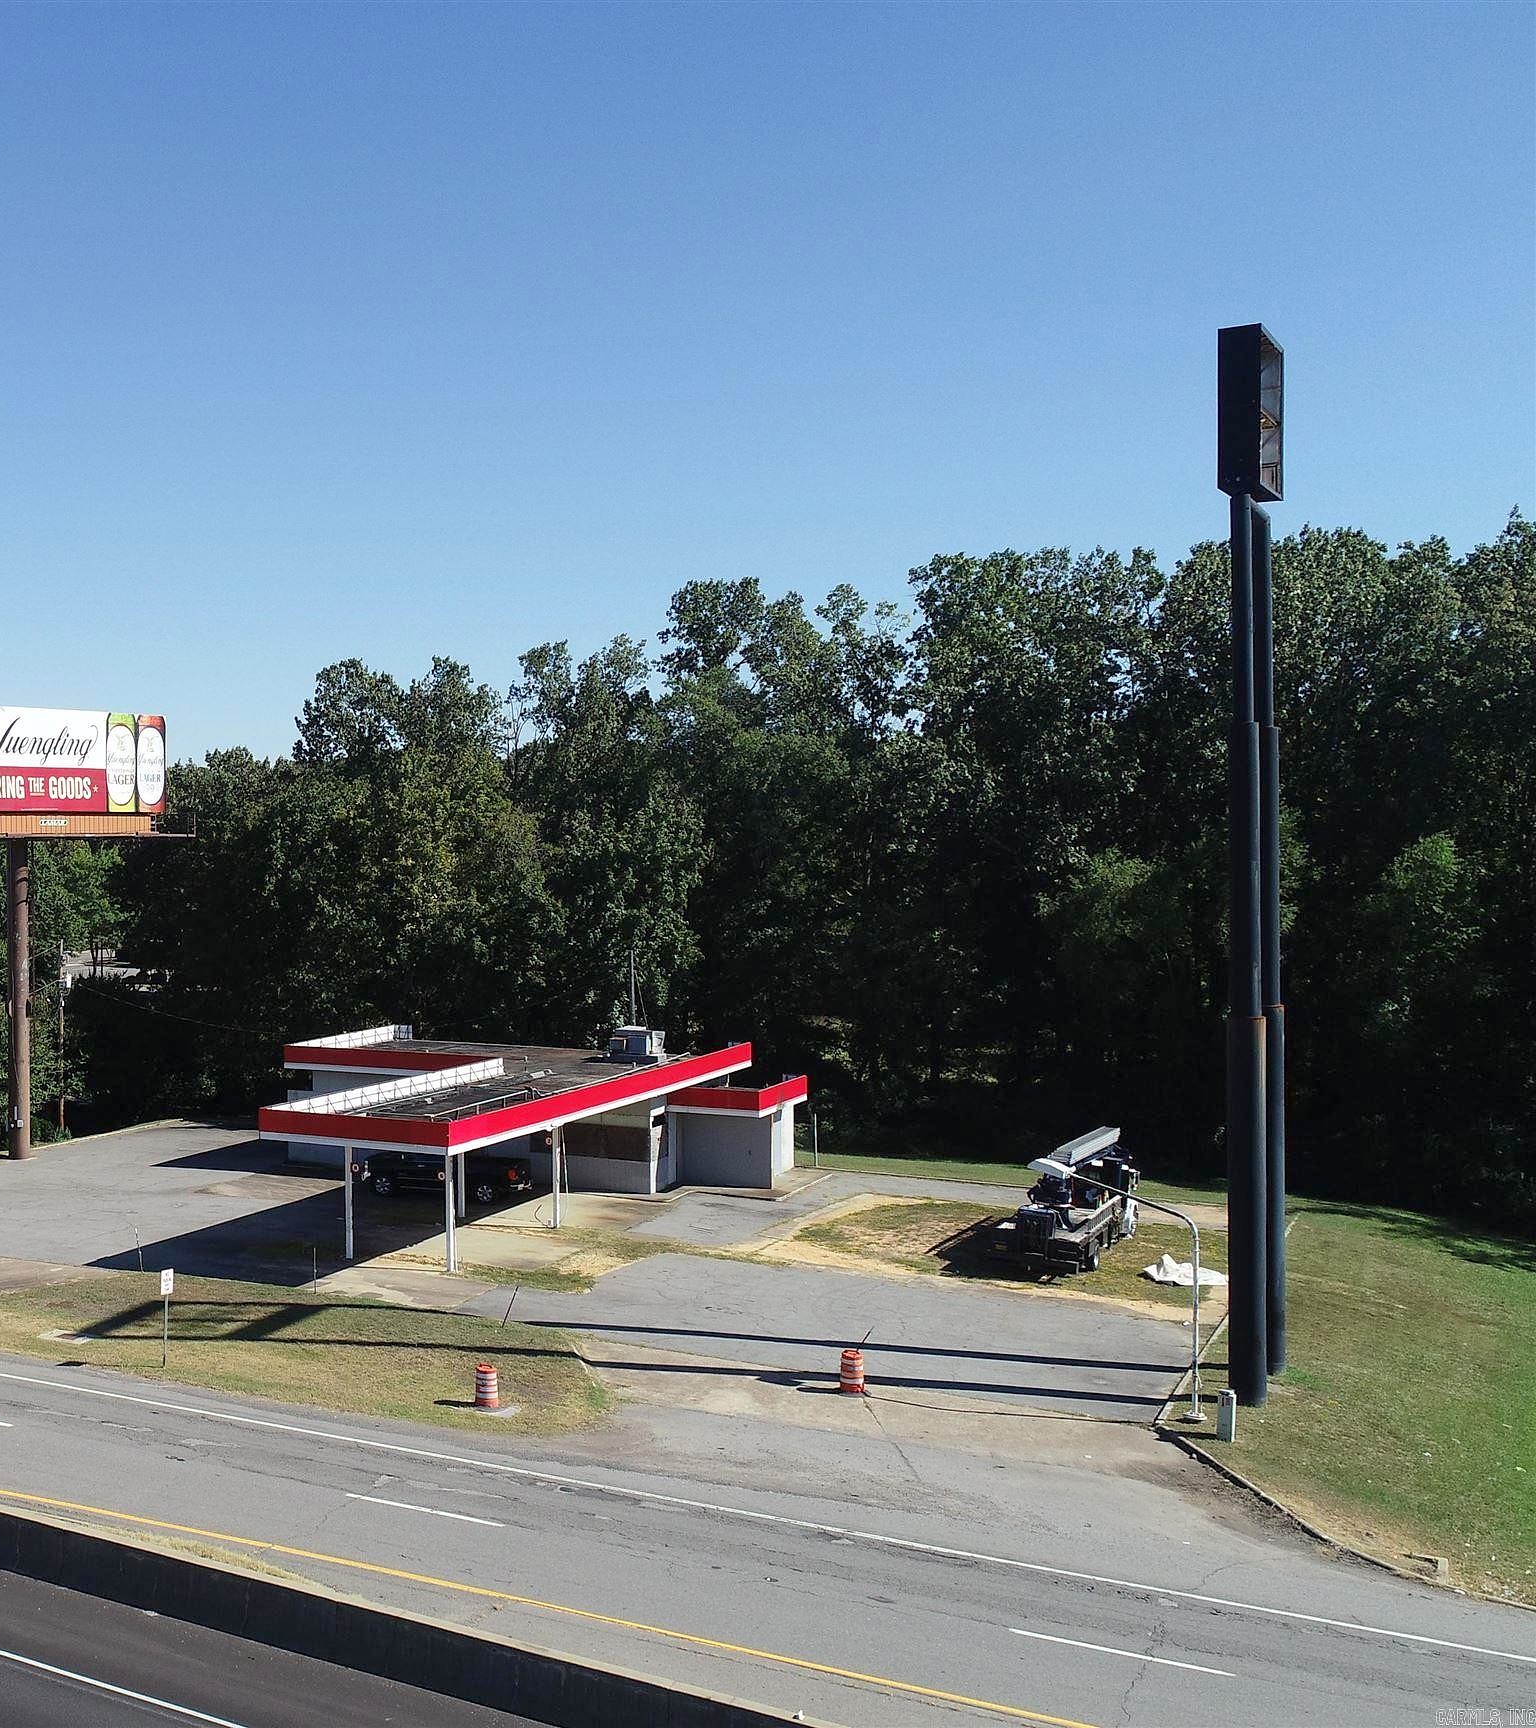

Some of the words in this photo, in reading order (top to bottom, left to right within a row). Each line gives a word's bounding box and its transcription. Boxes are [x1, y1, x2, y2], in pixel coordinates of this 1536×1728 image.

[28, 777, 45, 793] THE
[49, 776, 92, 800] GOODS
[108, 773, 135, 785] LAGER
